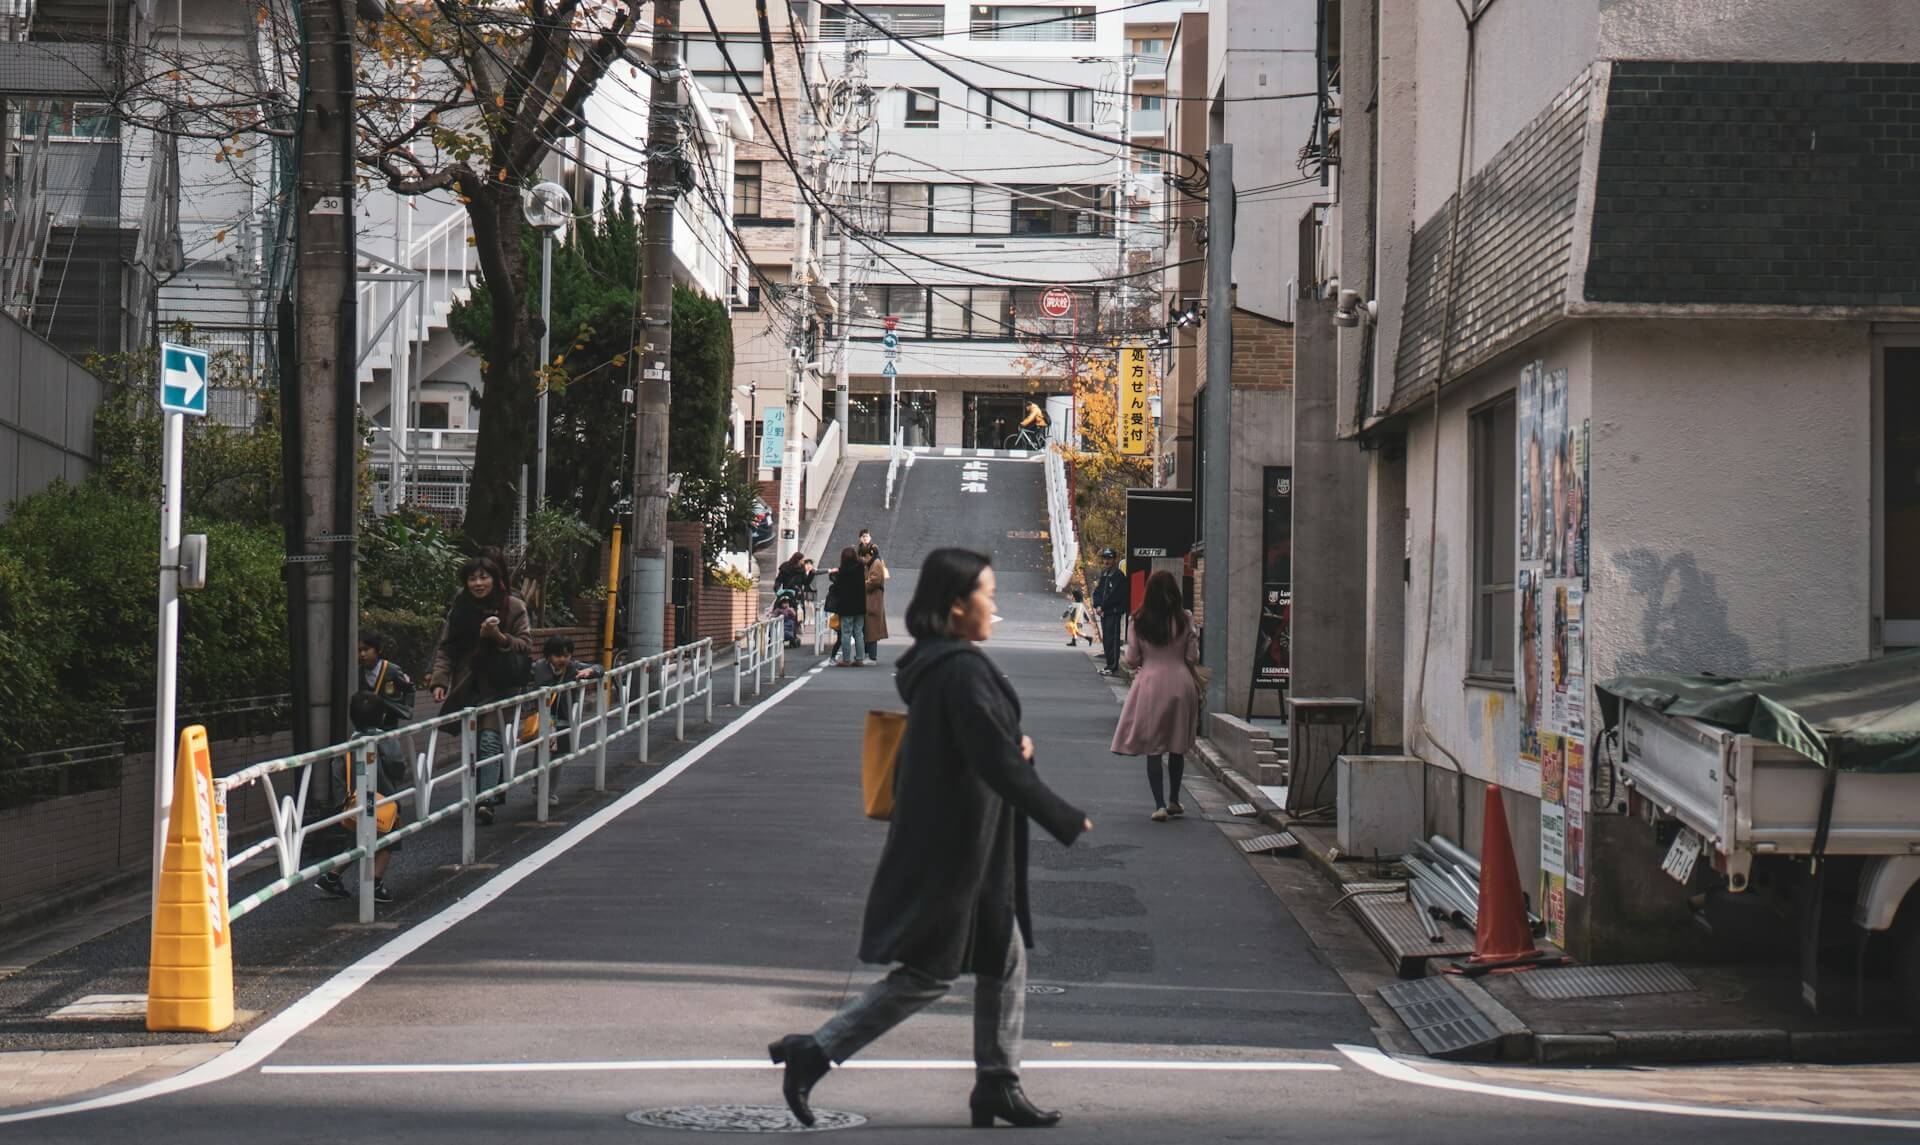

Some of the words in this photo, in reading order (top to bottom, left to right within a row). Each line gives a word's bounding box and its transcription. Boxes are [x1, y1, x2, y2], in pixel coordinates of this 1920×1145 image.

[323, 200, 338, 209] 30
[1131, 348, 1144, 441] 処方せん受付
[961, 461, 988, 493] 止まれ
